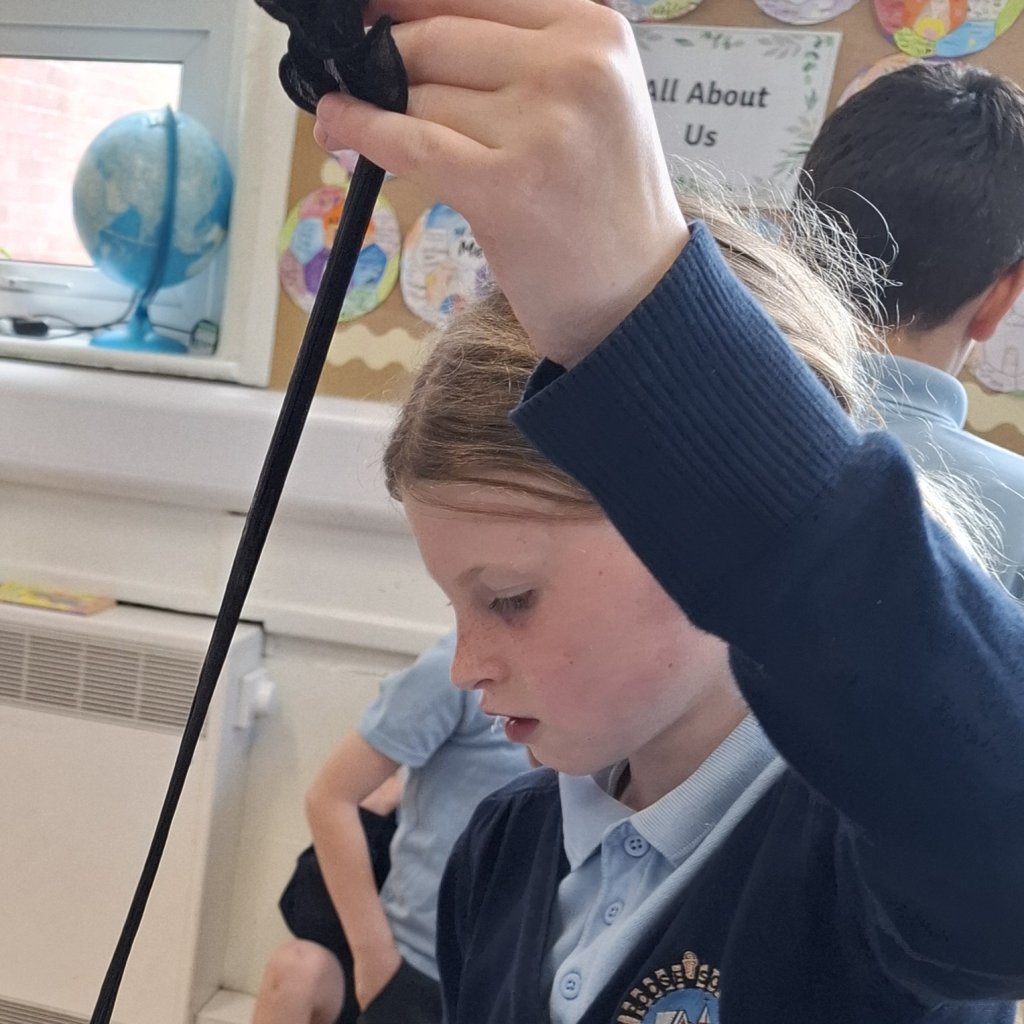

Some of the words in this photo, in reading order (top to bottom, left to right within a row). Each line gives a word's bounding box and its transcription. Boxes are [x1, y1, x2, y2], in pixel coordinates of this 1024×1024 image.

[647, 79, 678, 102] All
[686, 80, 770, 108] About
[684, 123, 718, 147] Us
